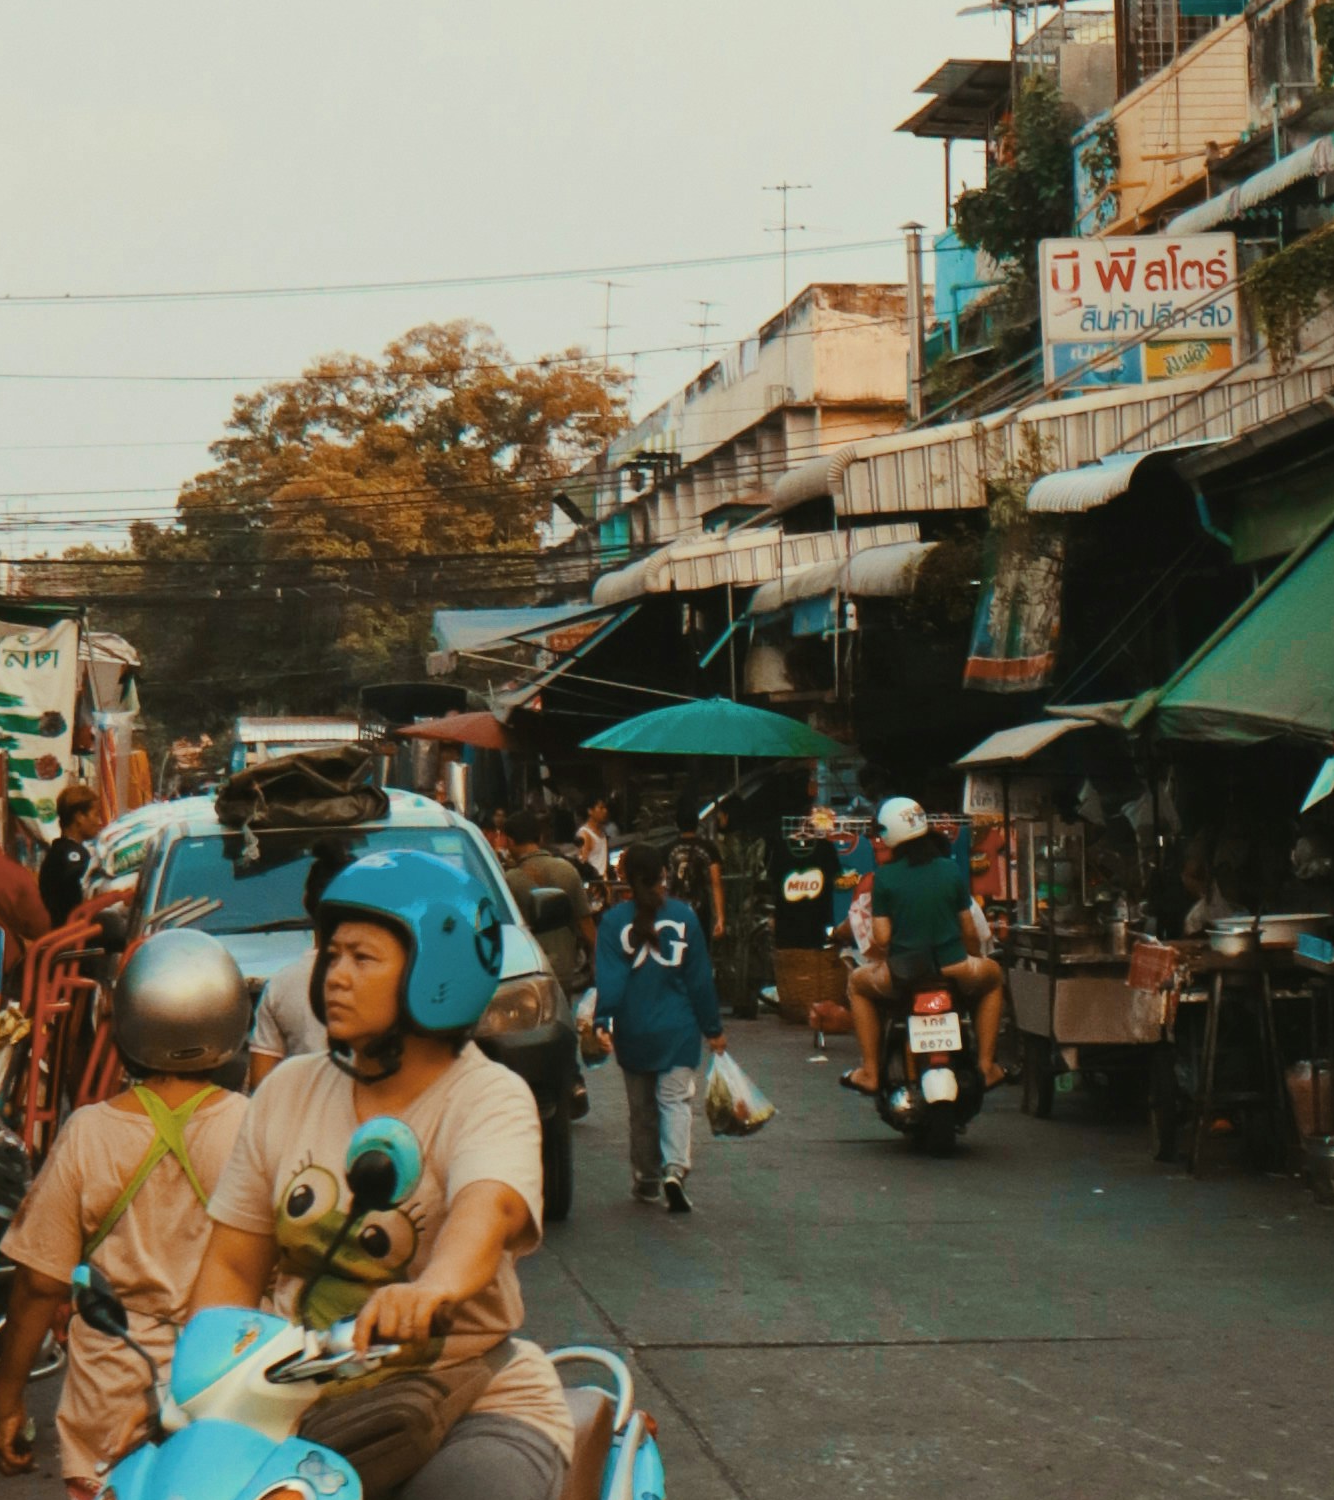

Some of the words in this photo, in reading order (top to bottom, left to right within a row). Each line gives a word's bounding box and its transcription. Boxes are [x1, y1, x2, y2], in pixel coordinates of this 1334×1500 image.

[1094, 247, 1137, 294] พี
[1144, 245, 1229, 292] สโตร์
[787, 880, 819, 891] MILO
